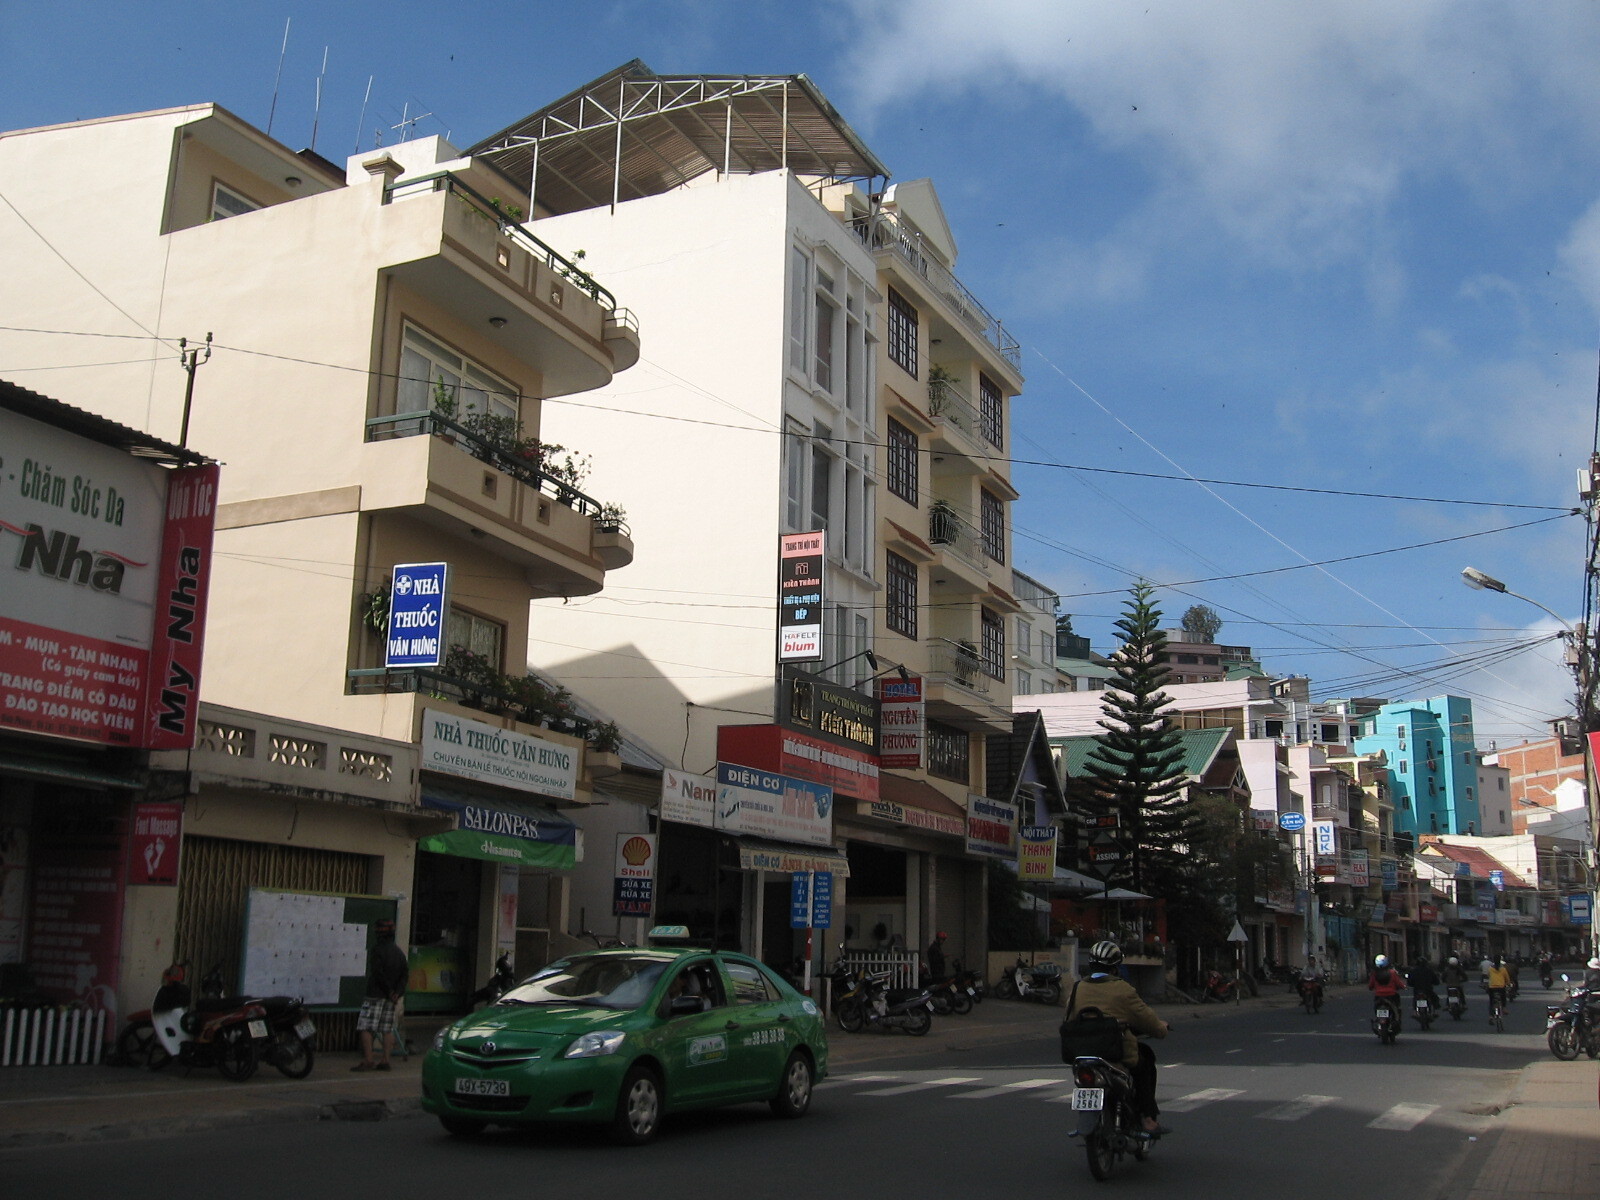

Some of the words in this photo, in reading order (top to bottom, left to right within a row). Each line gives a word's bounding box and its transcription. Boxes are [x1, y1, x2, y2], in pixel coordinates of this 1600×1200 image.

[21, 458, 66, 508] Chăm
[71, 474, 100, 519] Sóc
[105, 486, 124, 526] Da
[17, 523, 126, 594] Nha
[166, 545, 201, 645] Nha
[412, 573, 441, 596] NHÀ
[395, 603, 437, 628] THUỐC
[24, 636, 59, 656] MỤN
[389, 636, 410, 657] VĂN
[411, 636, 437, 656] HƯNG
[784, 641, 815, 653] blum
[93, 671, 115, 683] cam
[158, 663, 196, 736] My
[885, 682, 919, 698] HOTEL
[5, 692, 38, 712] ĐÀO
[41, 700, 69, 720] TẠO
[71, 706, 99, 726] HỌC
[101, 711, 135, 731] VIÊN
[433, 721, 463, 746] NHÀ
[466, 729, 509, 755] THUỐC
[512, 740, 536, 763] VĂN
[539, 748, 570, 771] HƯNG
[681, 779, 716, 802] Nam
[727, 769, 759, 787] ĐIỆN
[762, 777, 780, 790] CƠ
[464, 805, 539, 840] SALONPAS
[1022, 844, 1052, 857] THANH
[621, 868, 650, 877] Shell
[640, 891, 651, 899] XE
[458, 1079, 507, 1095] 49X-5739
